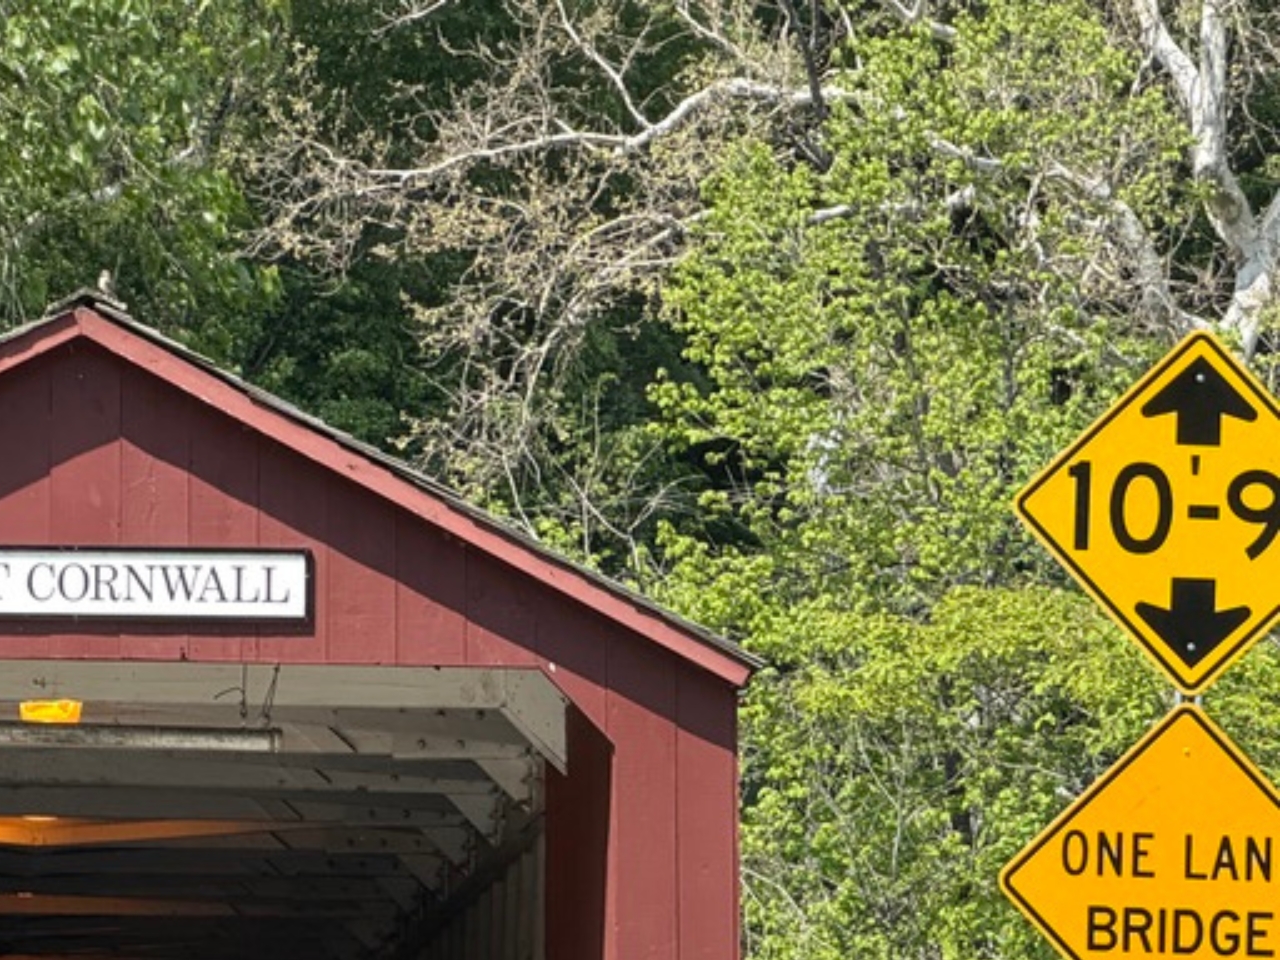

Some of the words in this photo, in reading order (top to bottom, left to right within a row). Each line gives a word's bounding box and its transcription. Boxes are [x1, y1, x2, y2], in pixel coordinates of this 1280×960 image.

[26, 562, 291, 604] CORNWALL
[1062, 829, 1155, 878] ONE
[1184, 833, 1272, 883] LAN
[1087, 905, 1275, 957] BRIDGE
